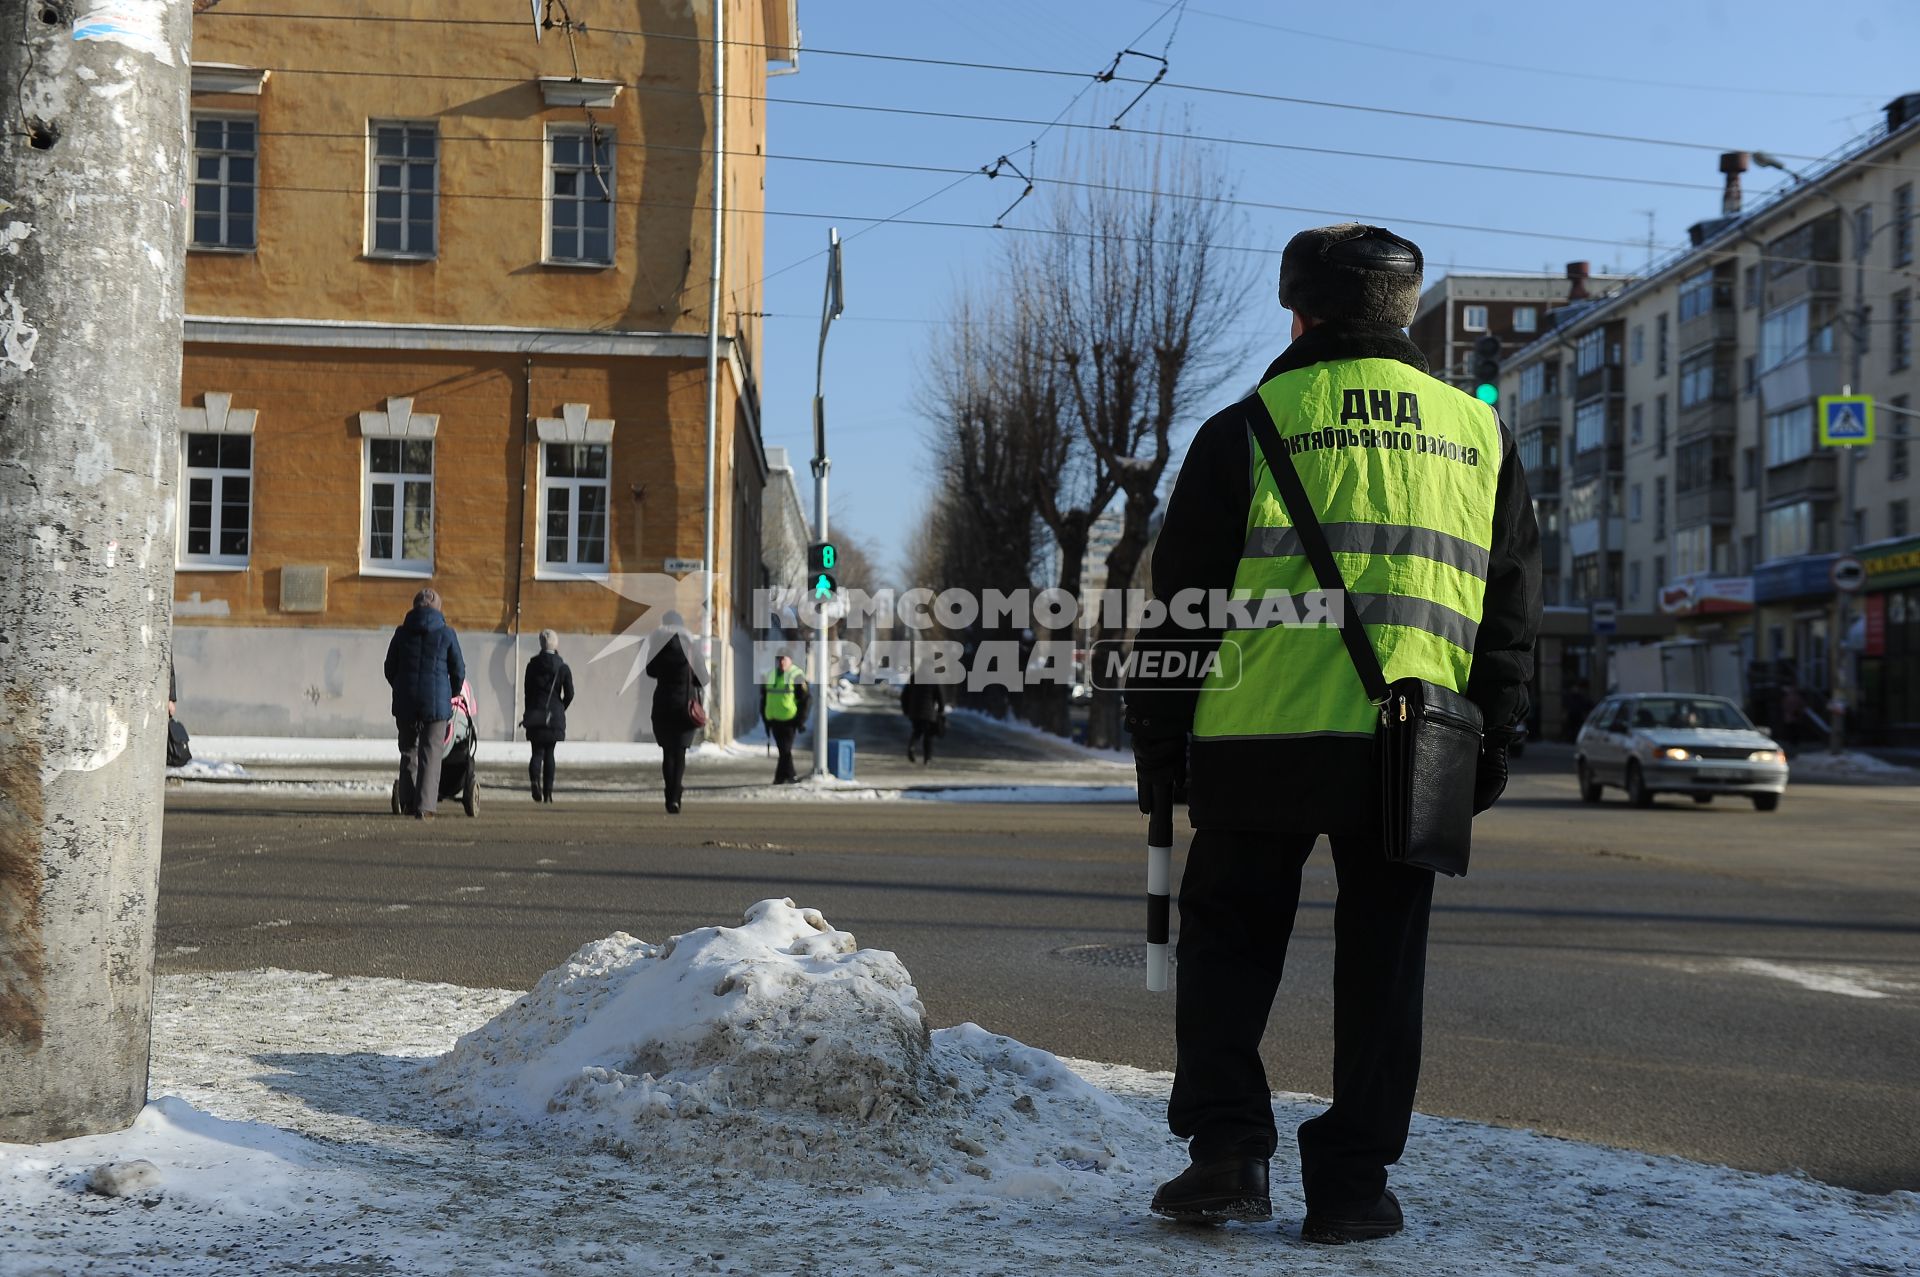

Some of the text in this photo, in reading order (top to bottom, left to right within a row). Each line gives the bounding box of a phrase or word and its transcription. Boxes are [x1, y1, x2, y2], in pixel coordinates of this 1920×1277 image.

[1340, 388, 1422, 431] ДНД
[1416, 434, 1478, 467] района
[822, 545, 835, 569] 8
